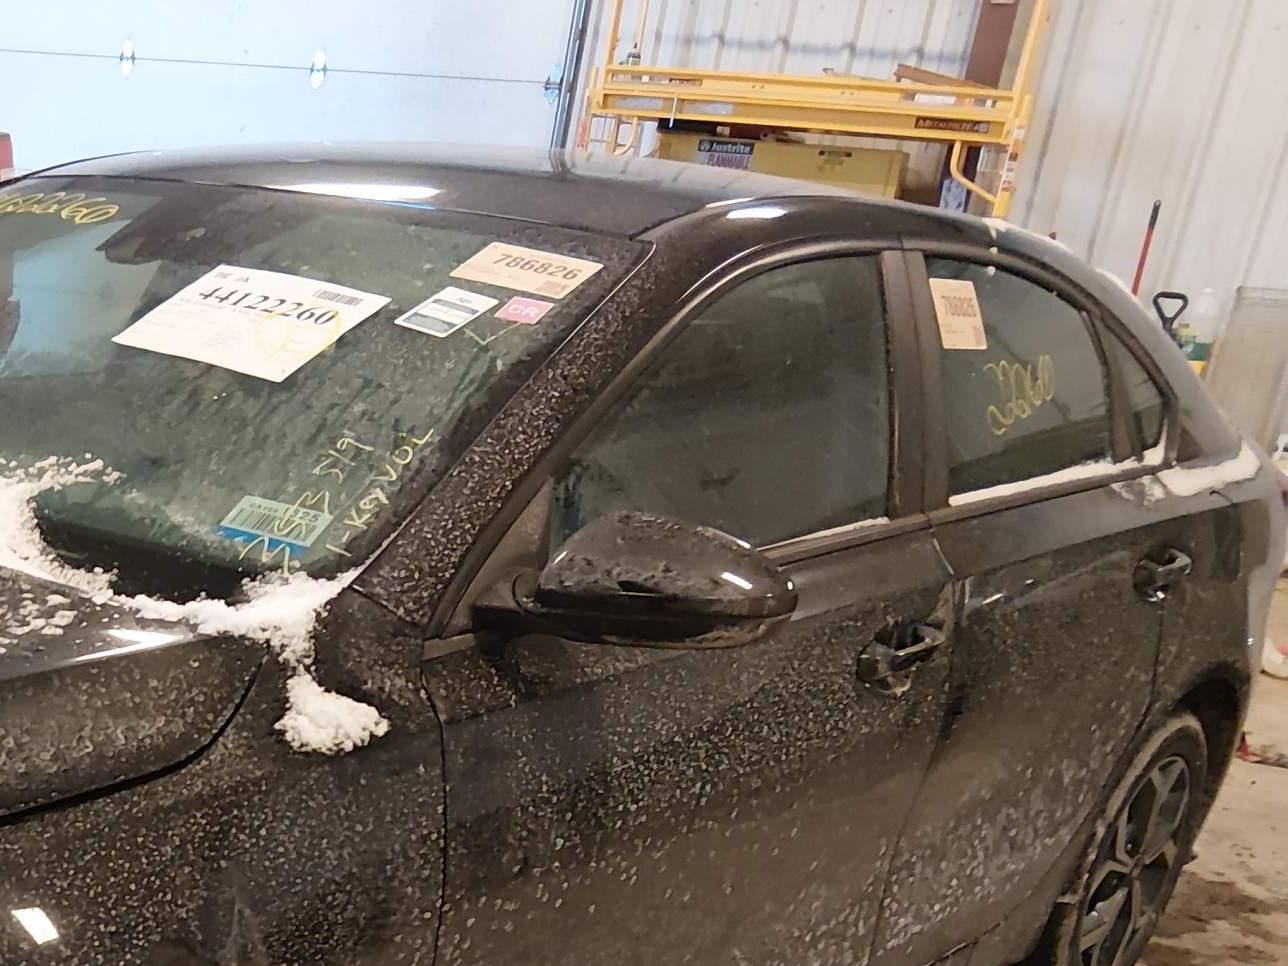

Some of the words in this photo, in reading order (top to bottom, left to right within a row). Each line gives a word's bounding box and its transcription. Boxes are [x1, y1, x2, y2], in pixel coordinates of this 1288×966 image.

[711, 141, 752, 154] Justrite
[492, 252, 583, 281] 786826
[198, 286, 340, 326] 44122260
[507, 303, 540, 319] CR
